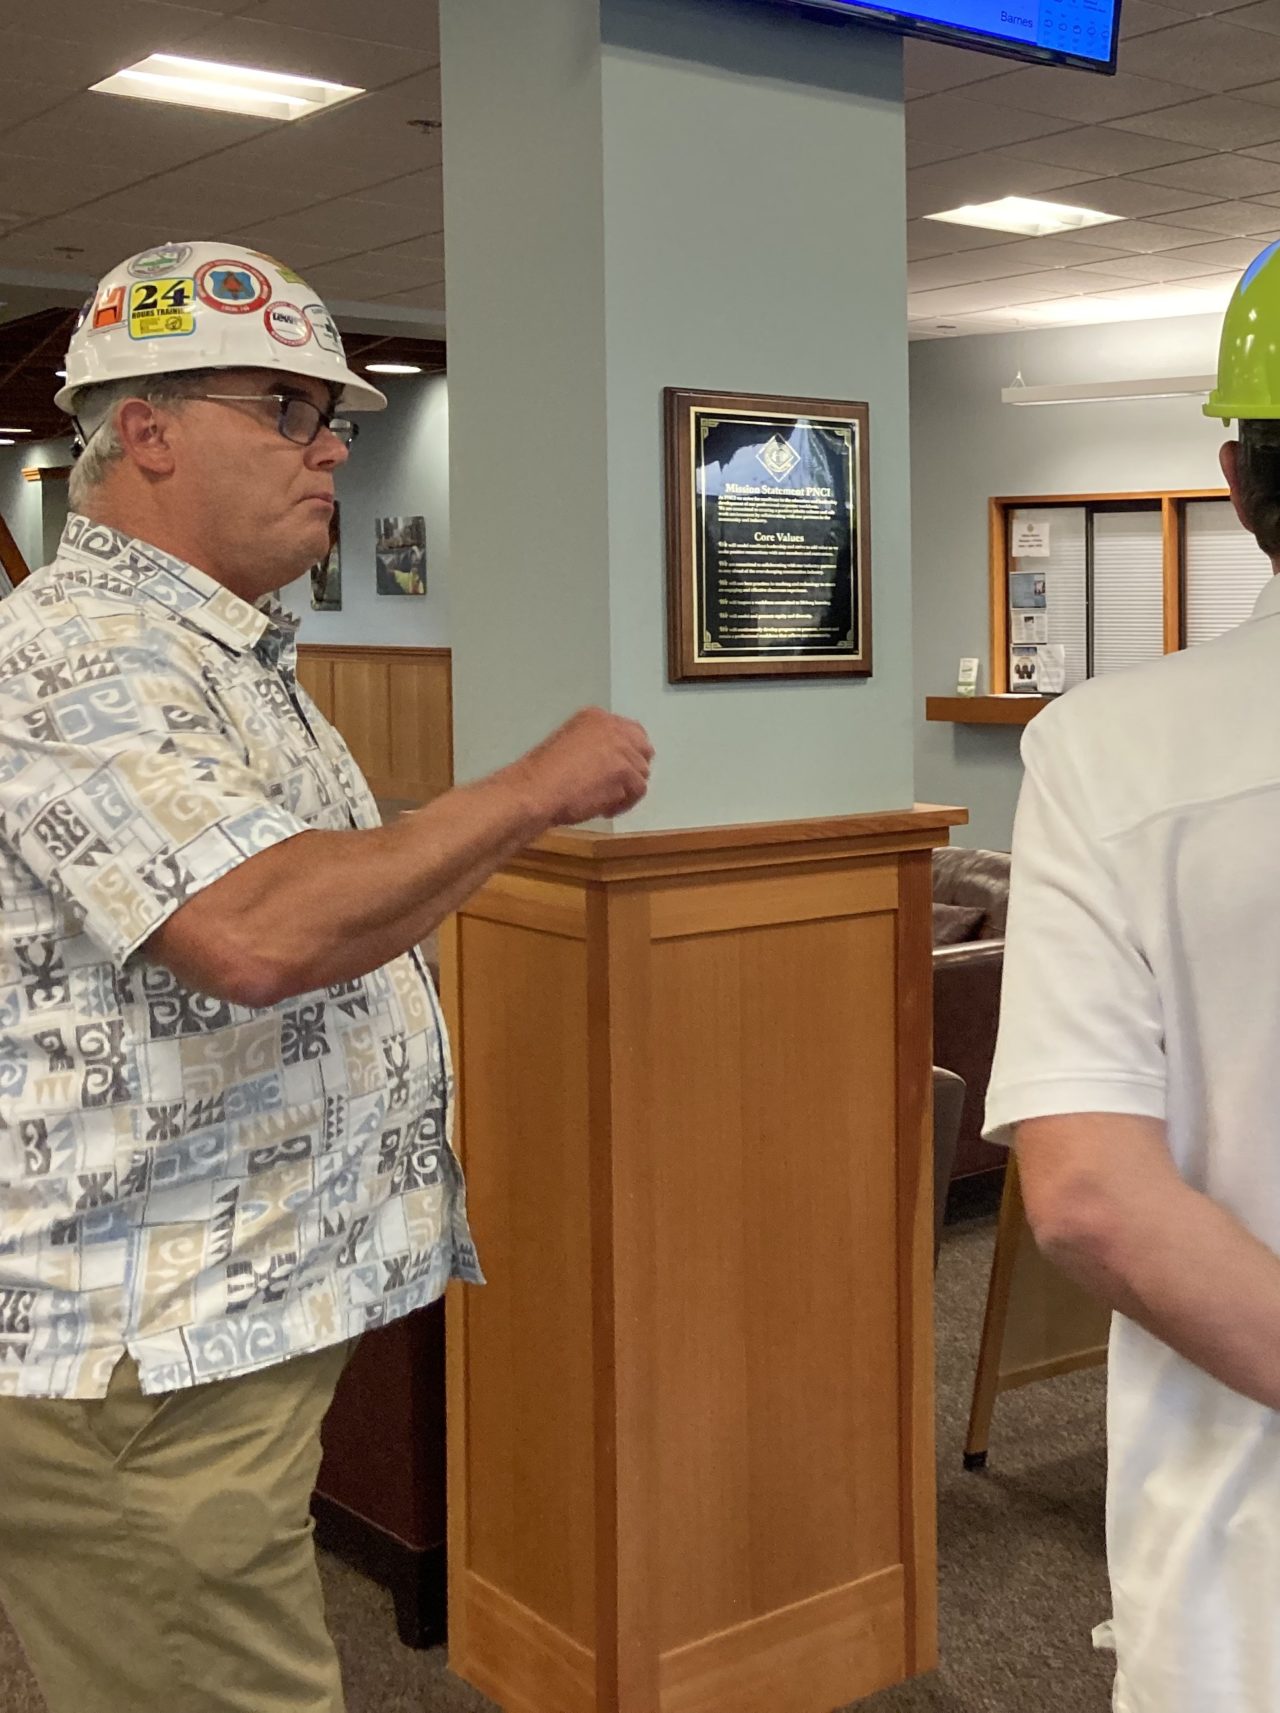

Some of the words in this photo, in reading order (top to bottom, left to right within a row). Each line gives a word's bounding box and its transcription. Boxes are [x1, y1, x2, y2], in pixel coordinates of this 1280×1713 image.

[1000, 11, 1032, 28] Barnes
[132, 280, 190, 311] 24
[131, 309, 155, 319] HOURS
[725, 483, 760, 495] Mission
[761, 485, 804, 496] Statement
[806, 487, 832, 497] PNCI
[754, 532, 775, 542] Core
[776, 532, 805, 543] Values
